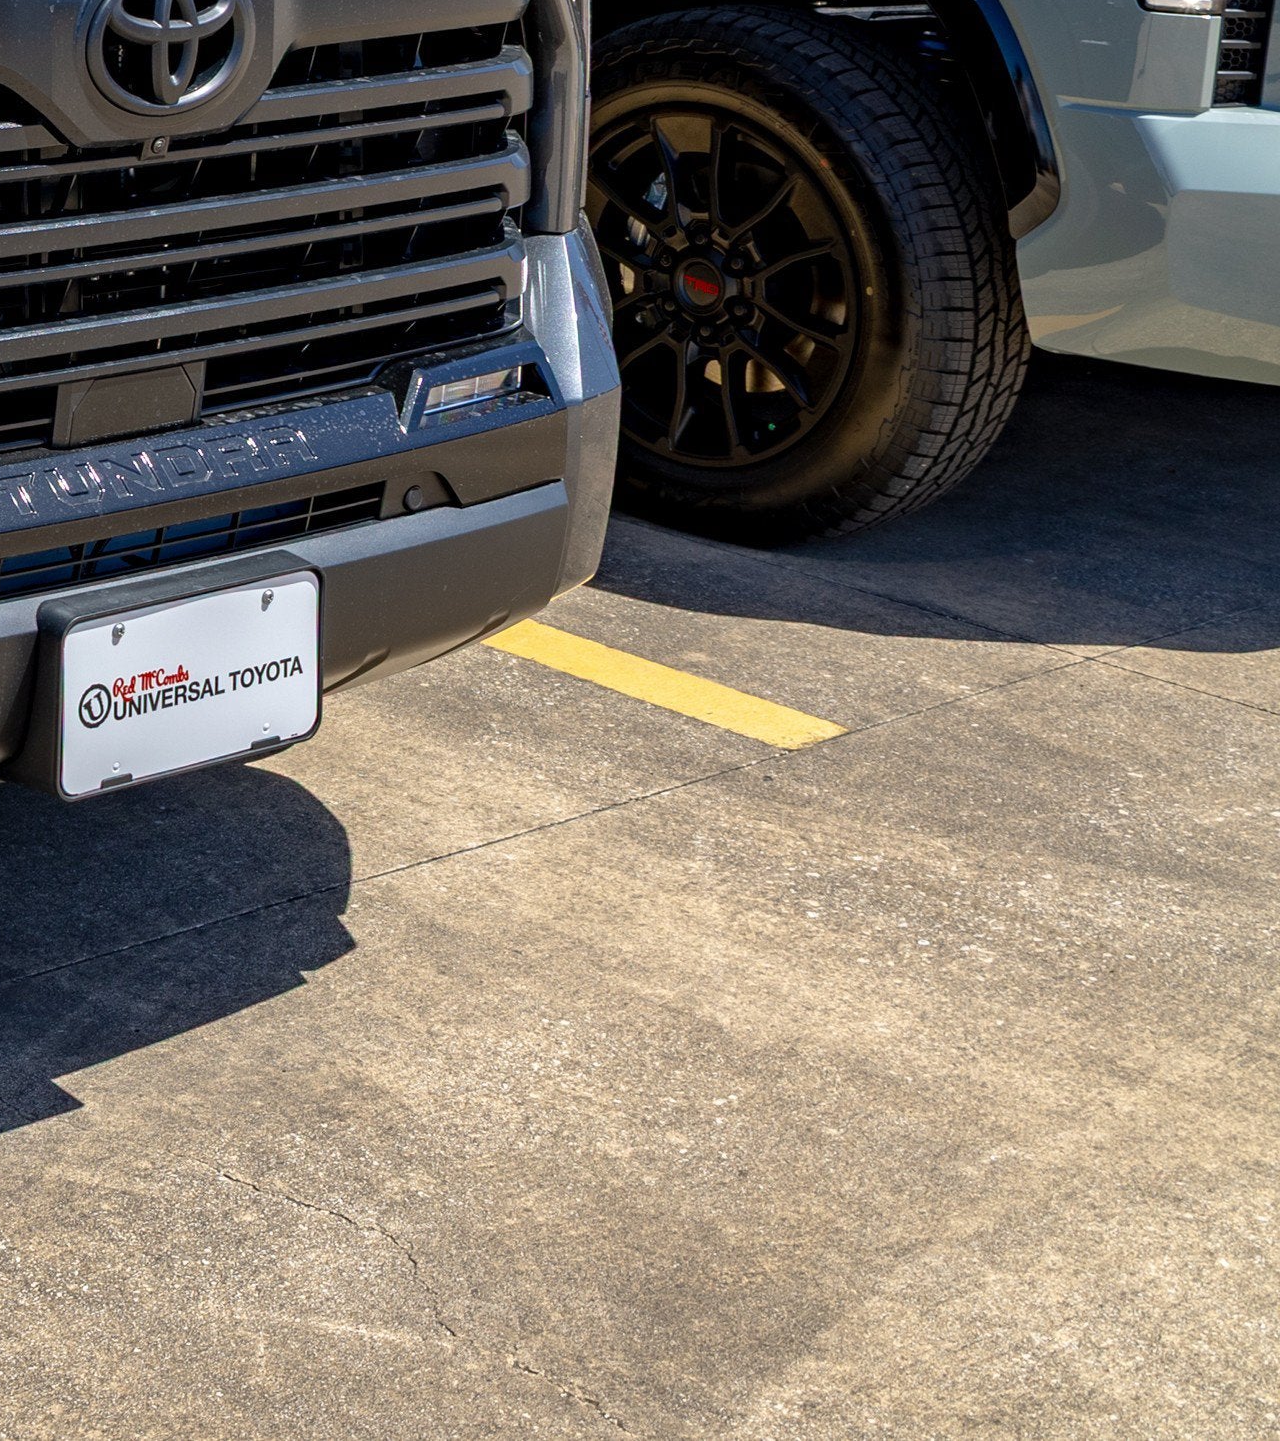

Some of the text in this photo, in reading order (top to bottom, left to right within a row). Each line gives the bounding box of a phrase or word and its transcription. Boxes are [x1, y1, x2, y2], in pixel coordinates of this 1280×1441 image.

[683, 273, 720, 297] TRD
[112, 664, 189, 702] Red McCombs
[113, 655, 304, 721] UNIVERSAL TOYOTA
